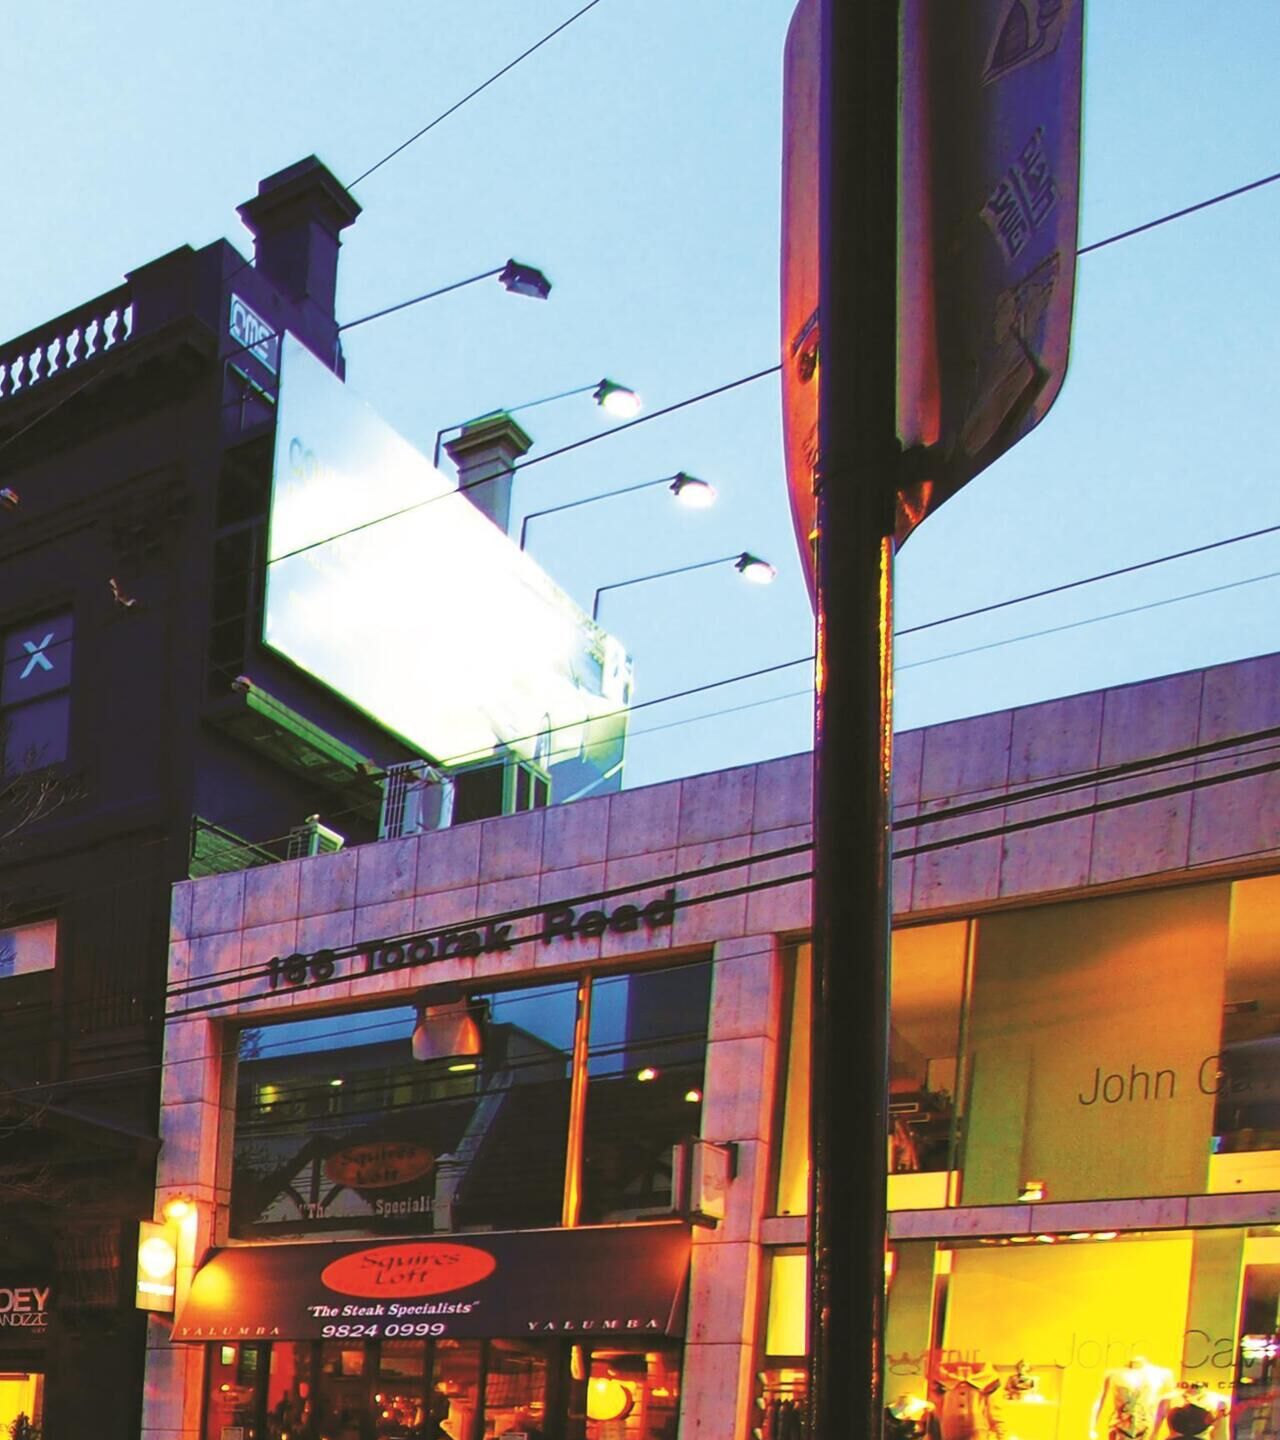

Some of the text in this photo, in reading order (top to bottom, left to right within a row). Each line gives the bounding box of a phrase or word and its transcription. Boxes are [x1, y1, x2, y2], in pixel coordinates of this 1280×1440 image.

[357, 920, 512, 973] Toorak
[543, 890, 676, 944] Road
[1078, 1064, 1175, 1106] John
[359, 1251, 462, 1271] Squires
[373, 1268, 428, 1286] Loft
[341, 1304, 385, 1317] Steak
[179, 1326, 281, 1336] YALUMBA
[322, 1322, 445, 1338] 9824 0999
[527, 1319, 659, 1331] YALUMBA
